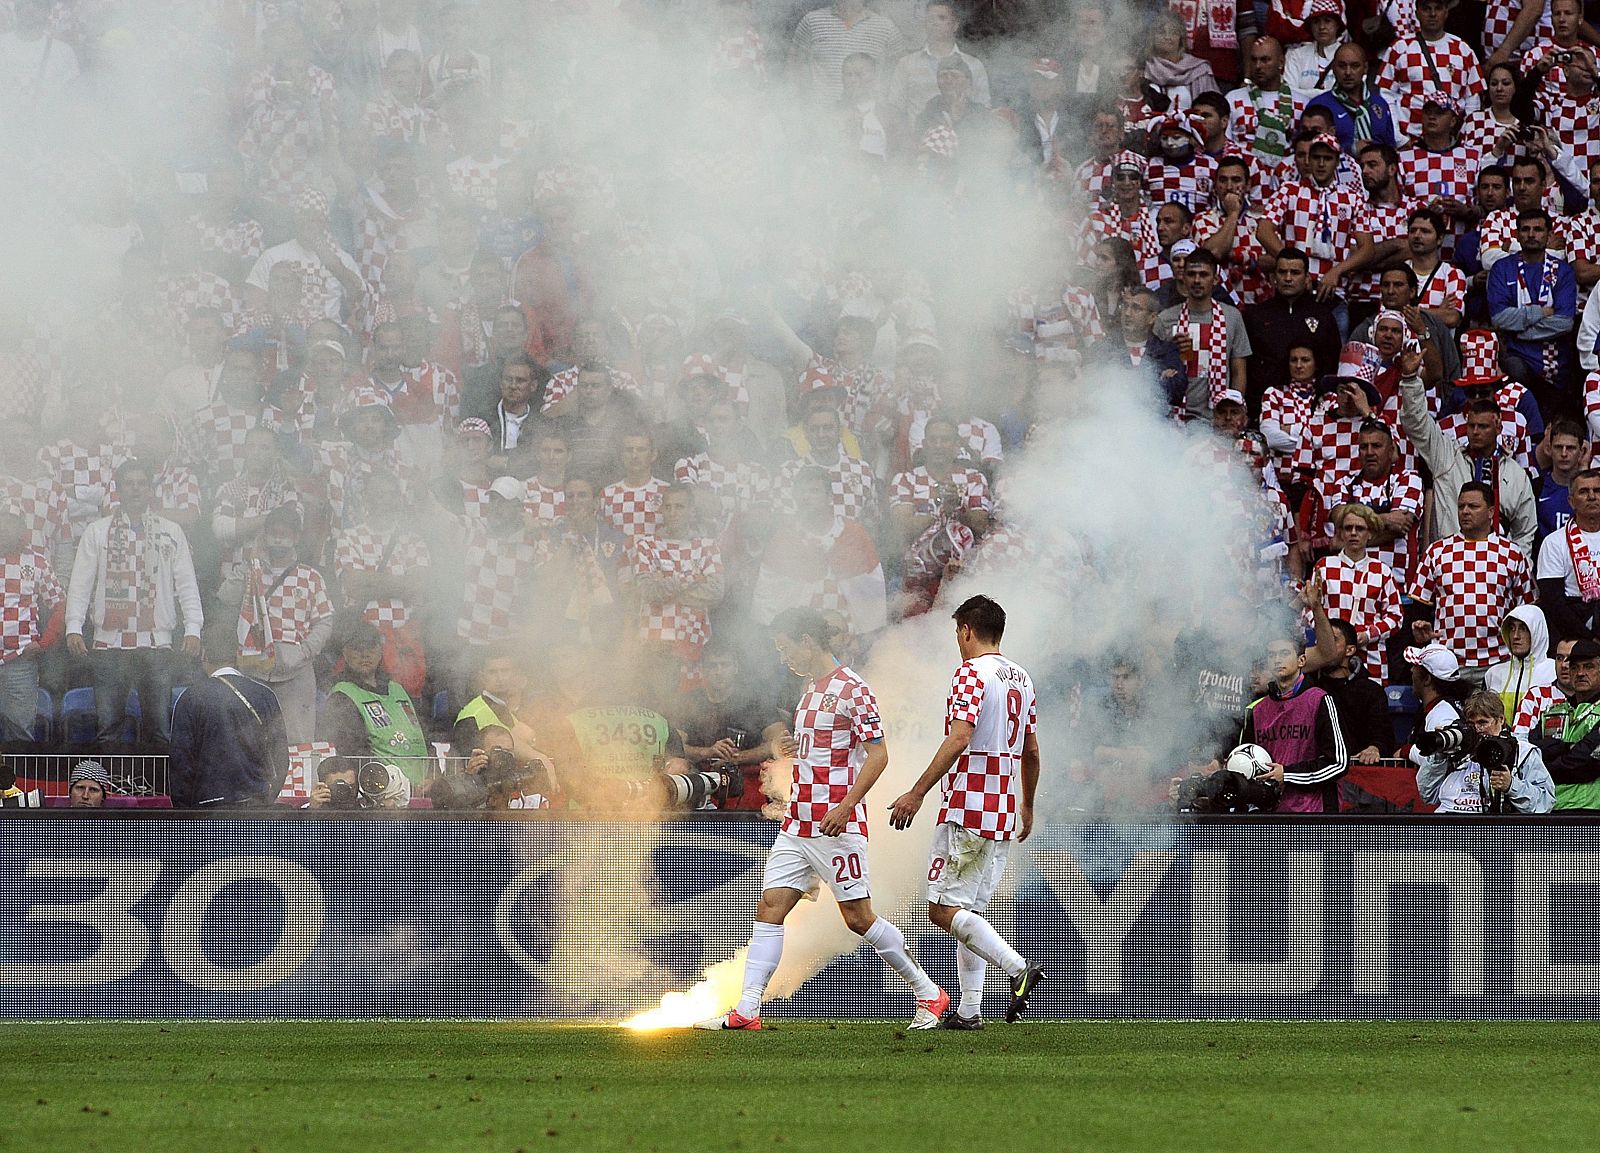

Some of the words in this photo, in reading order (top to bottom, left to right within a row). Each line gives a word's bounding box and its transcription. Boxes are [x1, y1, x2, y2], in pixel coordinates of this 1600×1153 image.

[587, 705, 655, 718] STEWARD
[595, 722, 657, 746] 3439
[1280, 724, 1311, 740] CREW
[832, 853, 862, 883] 20
[928, 858, 945, 881] 8
